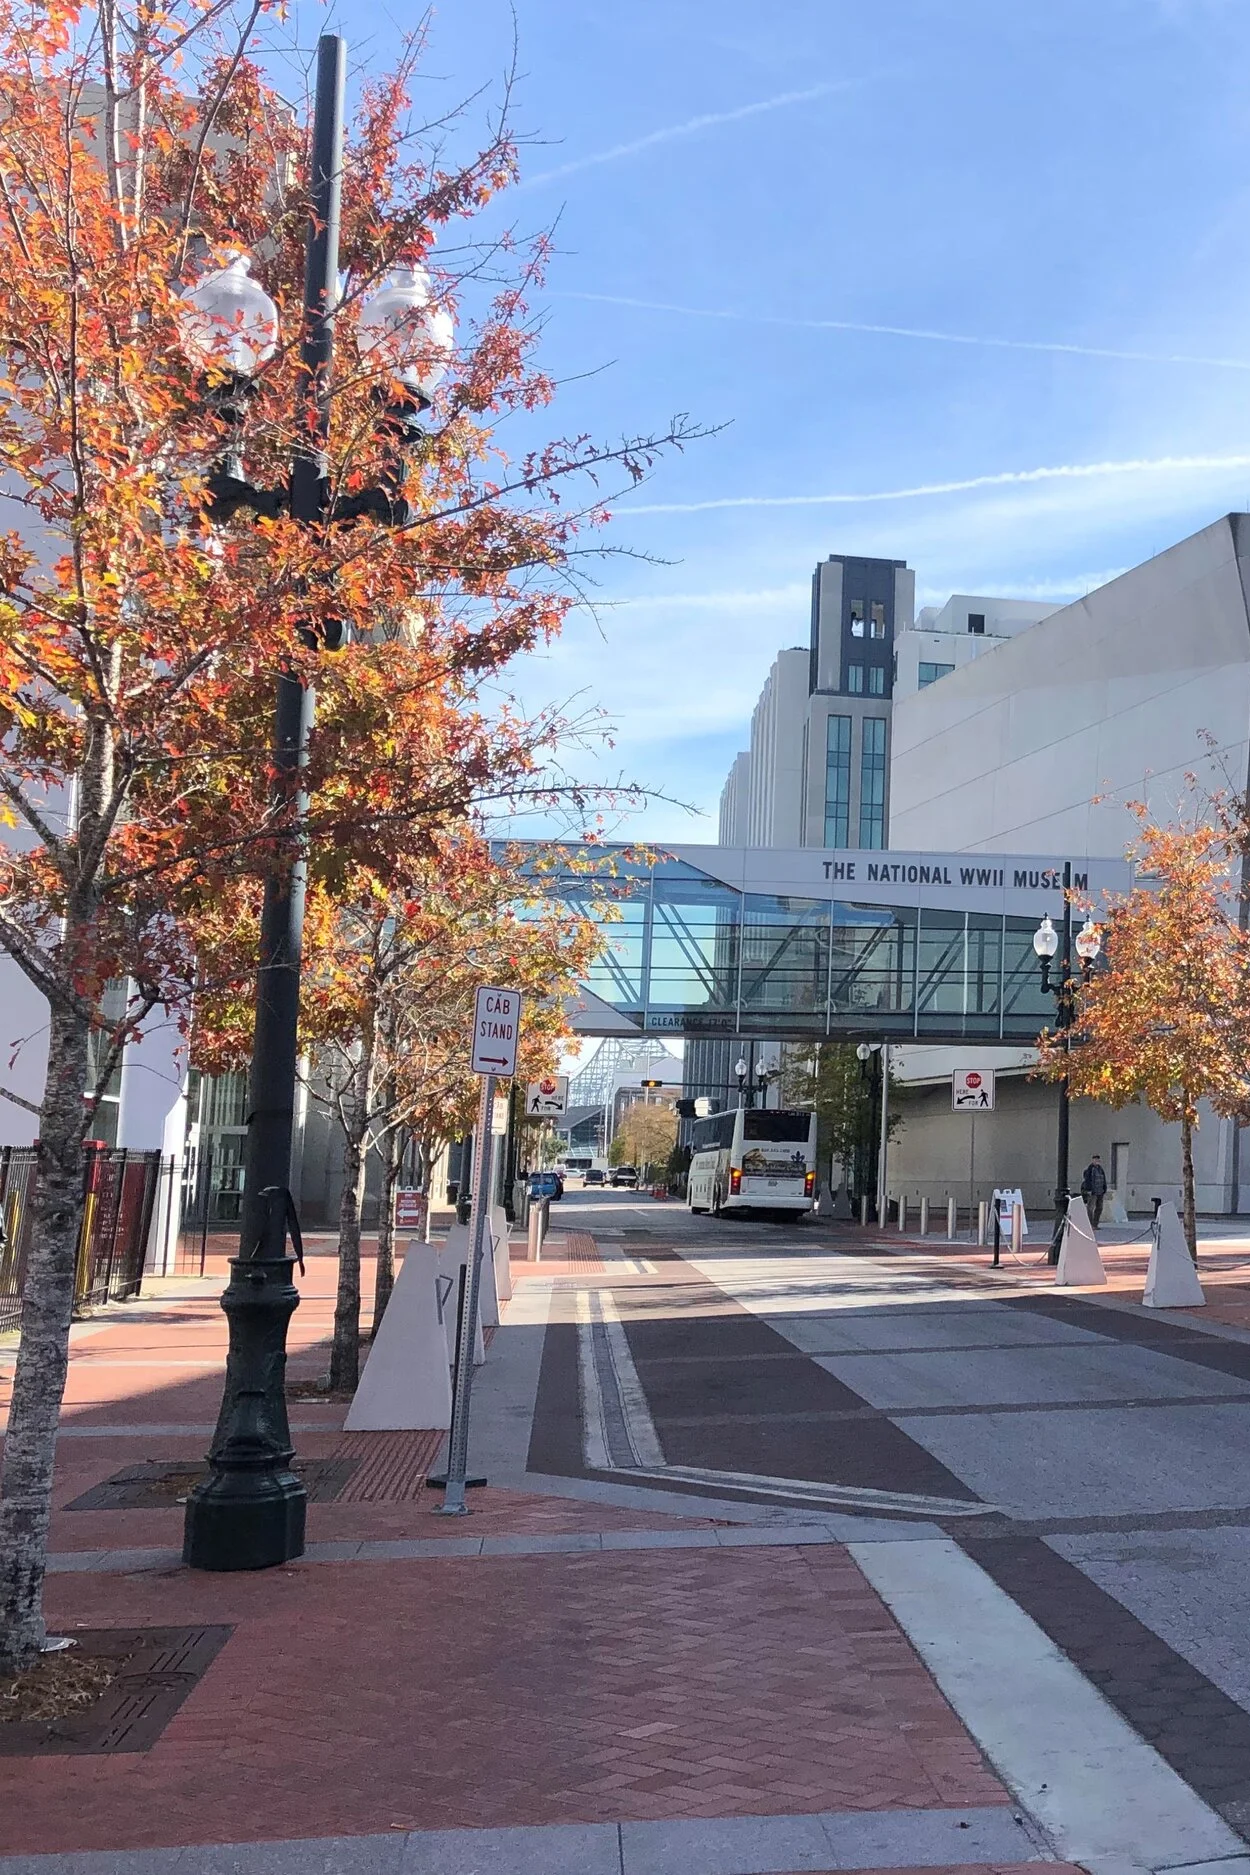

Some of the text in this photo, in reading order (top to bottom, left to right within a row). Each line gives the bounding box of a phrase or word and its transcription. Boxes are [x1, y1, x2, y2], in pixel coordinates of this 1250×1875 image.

[823, 861, 856, 881] THE
[867, 863, 952, 885] NATIONAL
[960, 867, 1004, 887] WWII
[486, 996, 511, 1015] CAB
[480, 1021, 513, 1040] STAND
[651, 1017, 704, 1027] CLEARANCE
